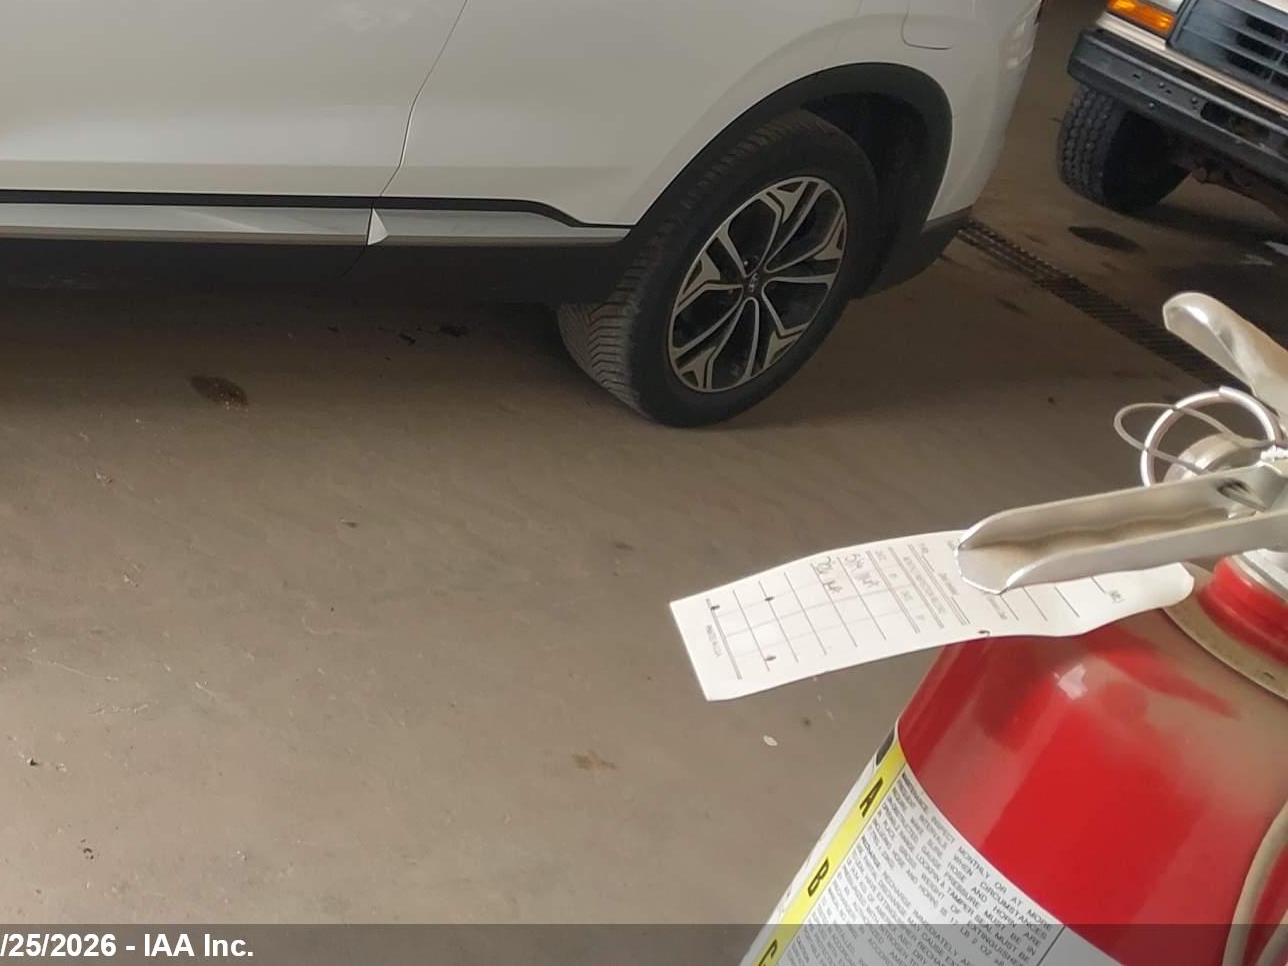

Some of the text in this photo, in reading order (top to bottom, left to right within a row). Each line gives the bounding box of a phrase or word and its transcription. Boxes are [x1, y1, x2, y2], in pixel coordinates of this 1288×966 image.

[860, 777, 884, 818] A
[807, 857, 830, 897] B
[956, 846, 990, 879] MONTHLY
[993, 880, 1007, 893] OR
[1011, 895, 1022, 906] AT
[970, 885, 988, 902] AND
